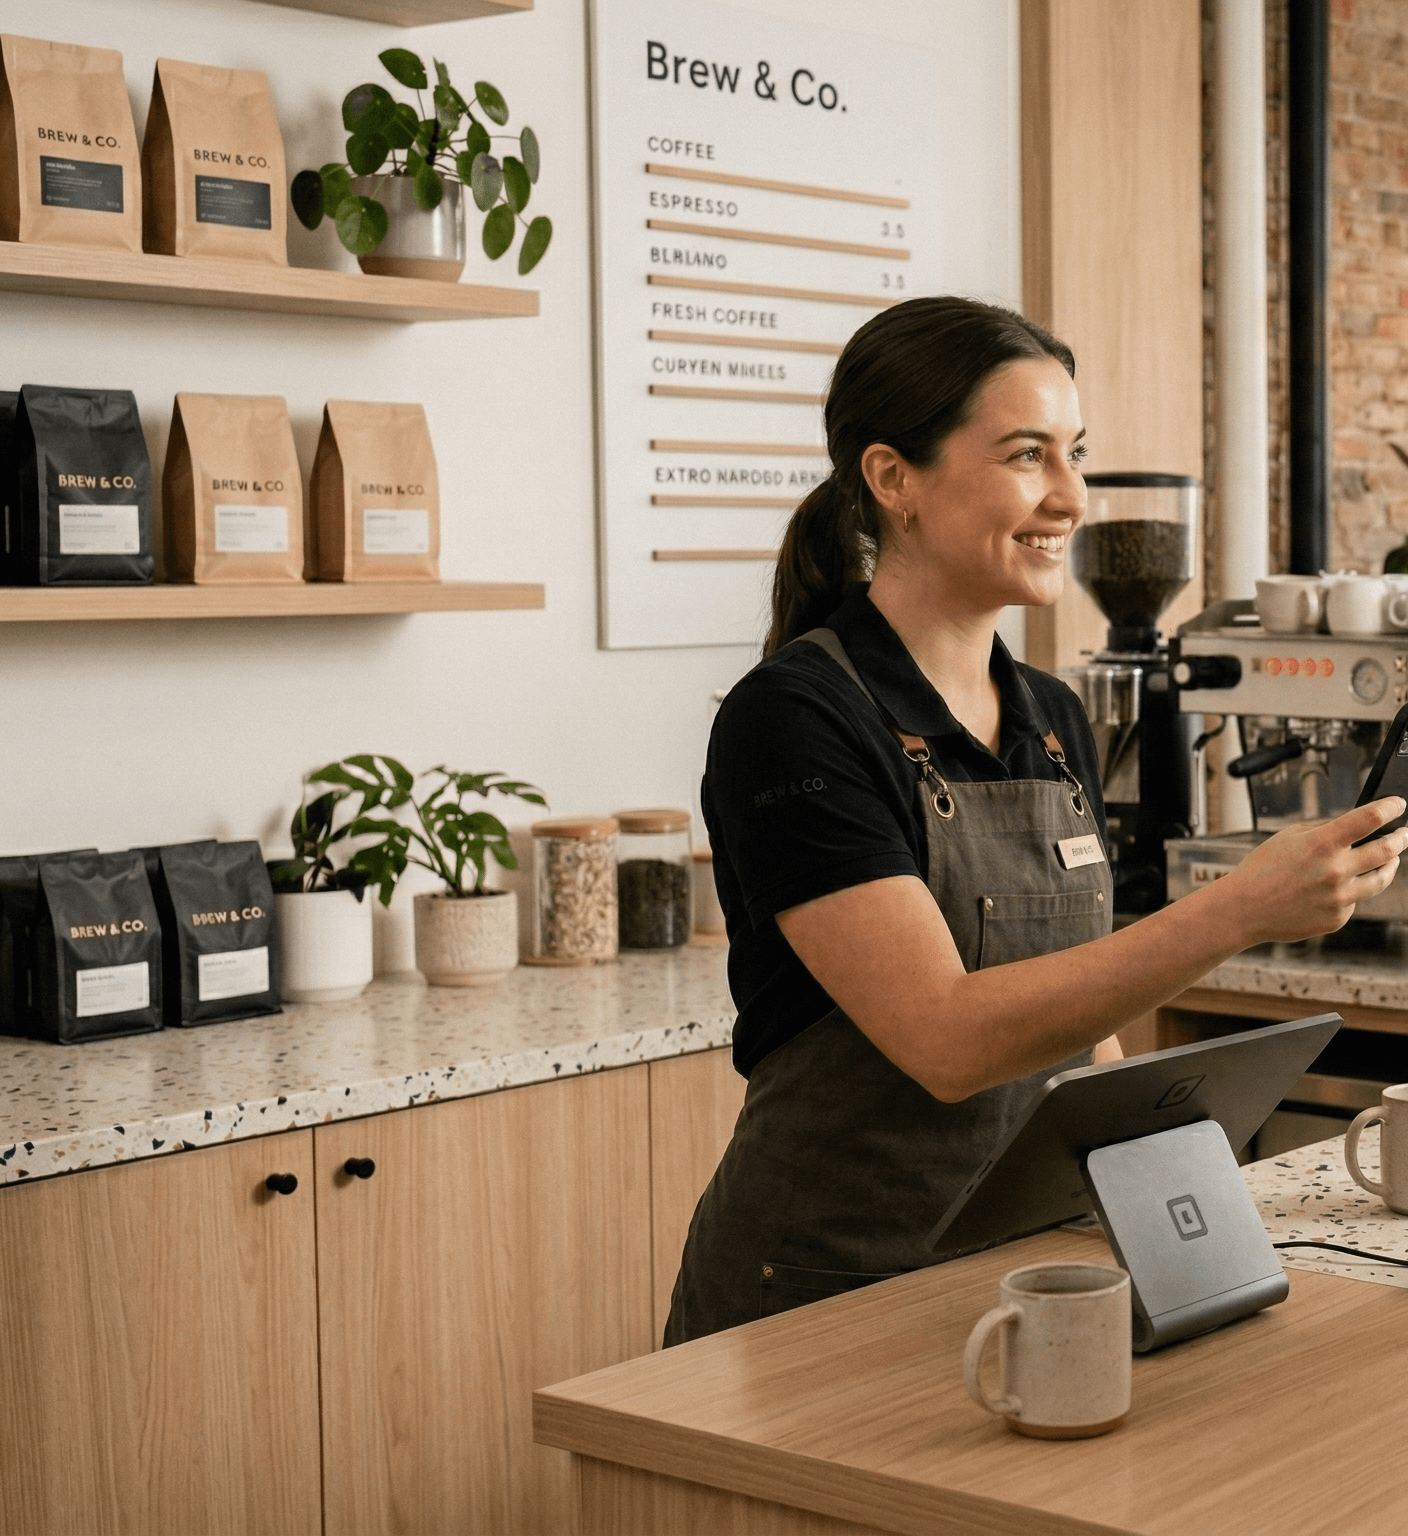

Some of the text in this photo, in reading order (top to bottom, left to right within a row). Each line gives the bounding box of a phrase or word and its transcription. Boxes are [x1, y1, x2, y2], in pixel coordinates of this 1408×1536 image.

[646, 40, 847, 112] Brew & Co.
[37, 127, 121, 149] BREW & CO.
[647, 136, 716, 160] COFFEE
[193, 148, 271, 169] BREW & CO.
[649, 191, 738, 217] ESPRESSO
[651, 302, 778, 329] FRESH COFFEE
[58, 474, 137, 489] BREW & CO.
[655, 467, 712, 485] EXTRO
[753, 785, 786, 808] BREW
[802, 777, 828, 792] CO.
[230, 910, 240, 922] &
[241, 906, 266, 920] CO.
[70, 919, 148, 939] BREW & CO.
